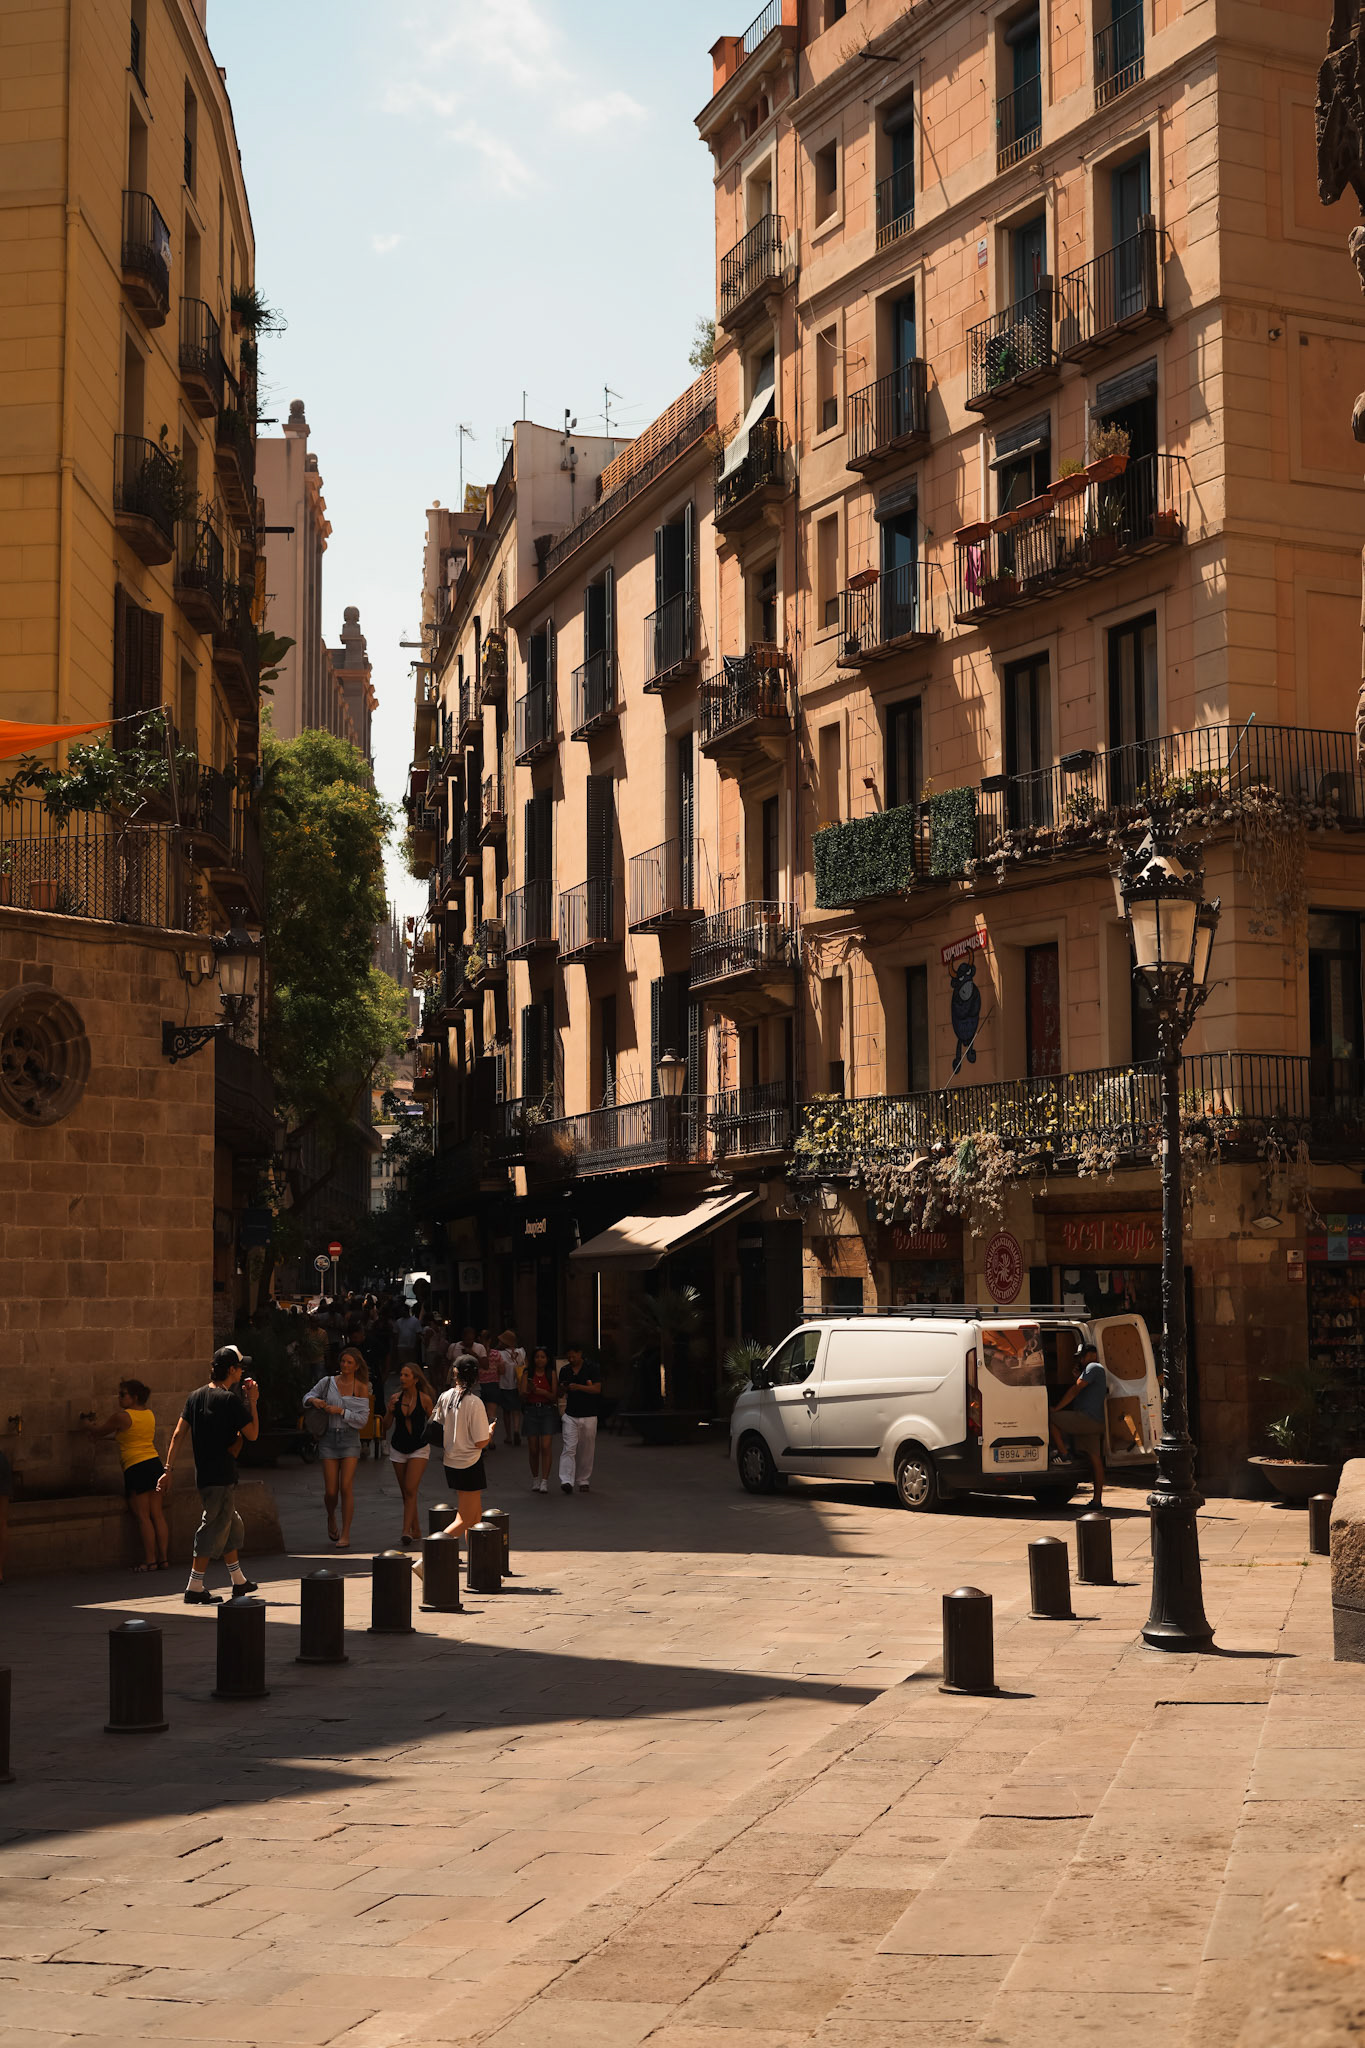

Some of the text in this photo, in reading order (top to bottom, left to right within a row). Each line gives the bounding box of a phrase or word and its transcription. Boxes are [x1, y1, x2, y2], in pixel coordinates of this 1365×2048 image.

[1062, 1221, 1155, 1259] BCN Style
[1000, 1449, 1037, 1459] 9894 JHG
